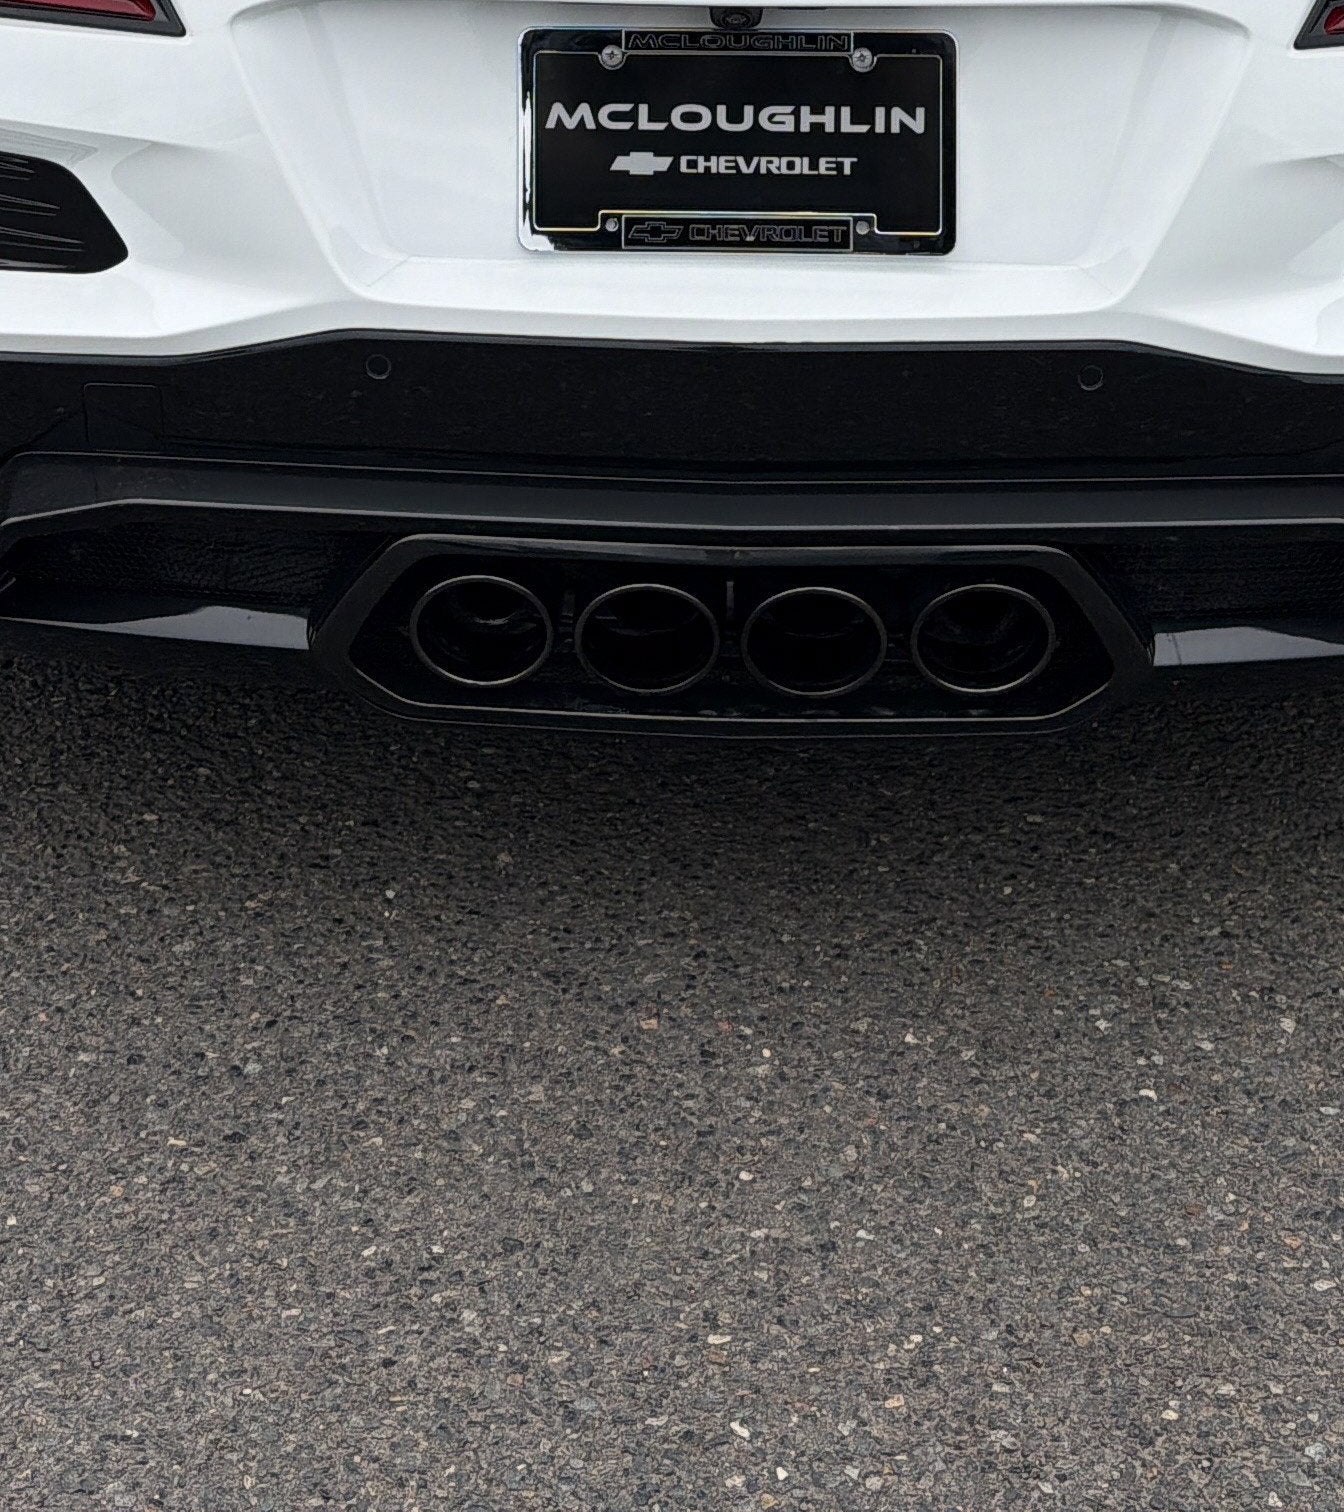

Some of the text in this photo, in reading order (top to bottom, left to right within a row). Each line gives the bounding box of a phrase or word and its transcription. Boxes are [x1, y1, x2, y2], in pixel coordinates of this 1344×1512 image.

[628, 33, 850, 51] MCLOUGHLIN
[545, 102, 926, 135] MCLOUGHLIN
[679, 154, 859, 176] CHEVROLET
[688, 223, 848, 243] CHEVROLET
